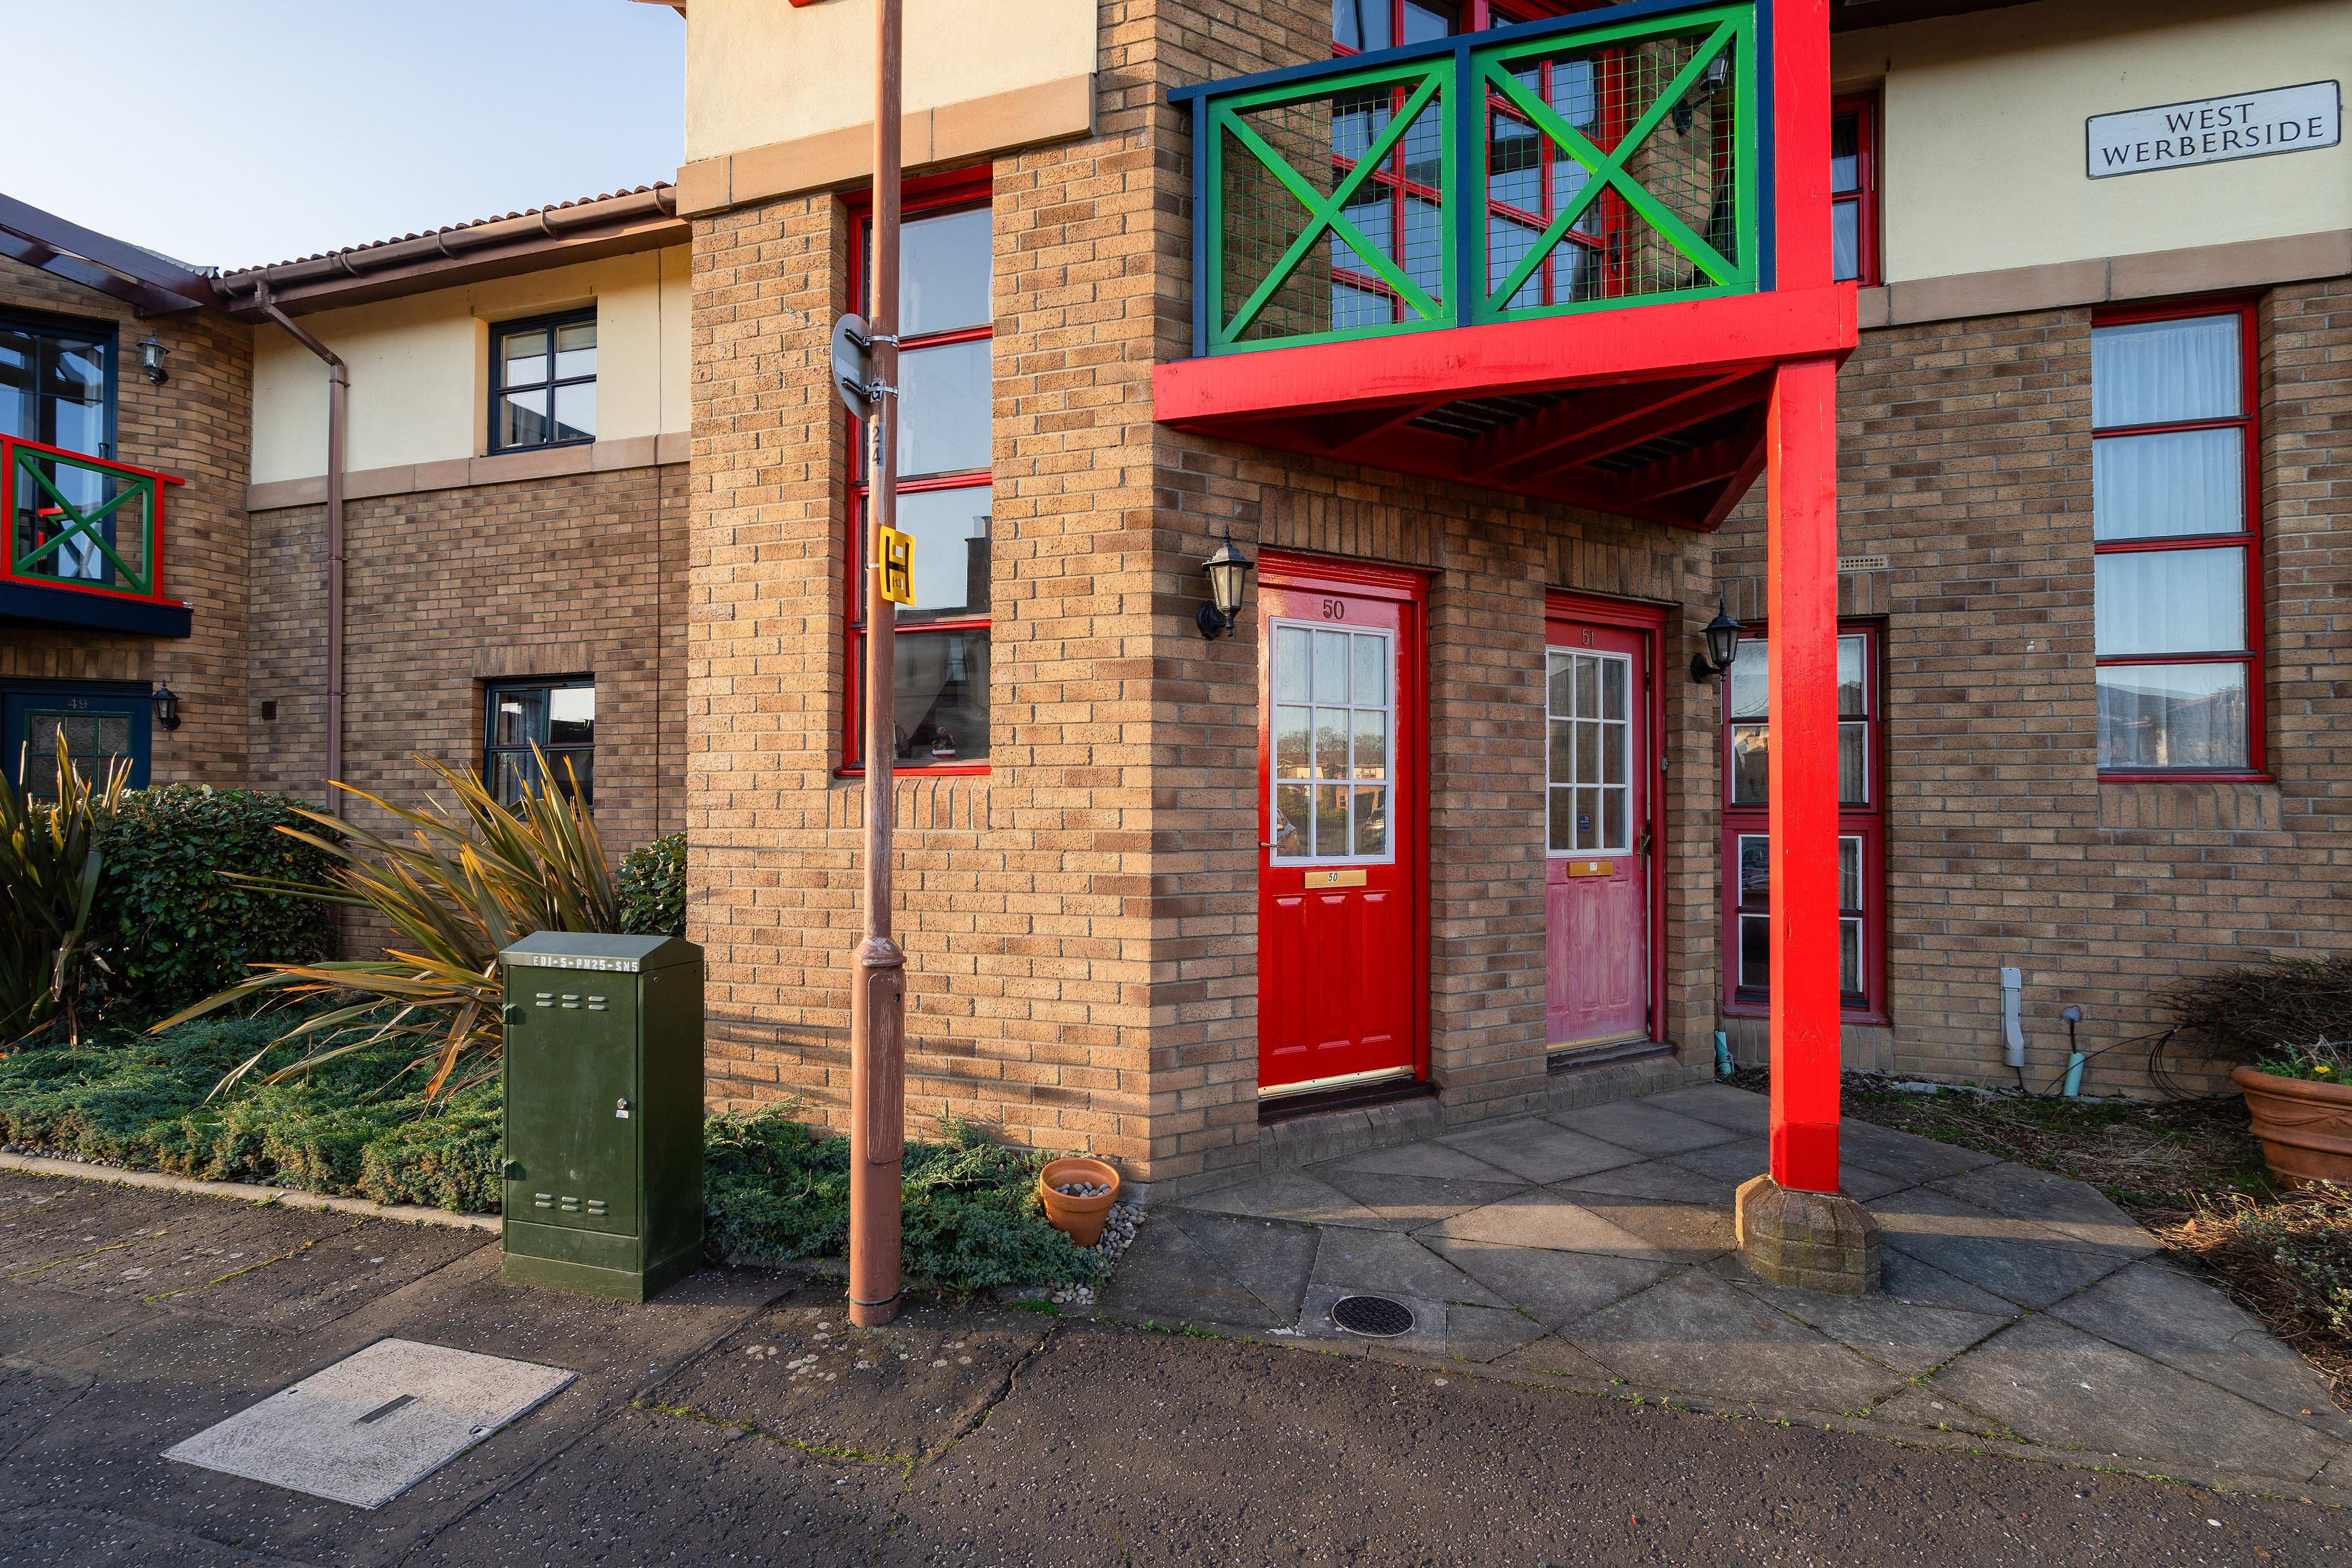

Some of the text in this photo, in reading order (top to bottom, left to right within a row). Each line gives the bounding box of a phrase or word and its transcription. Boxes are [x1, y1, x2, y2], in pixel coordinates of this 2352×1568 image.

[2165, 102, 2255, 134] WEST
[2101, 116, 2325, 167] WERBERSIDE
[1323, 599, 1345, 619] 50
[1582, 629, 1594, 646] 51
[67, 698, 88, 709] 49
[1328, 873, 1338, 881] 50
[533, 956, 638, 972] EDI-5-PN25-SN5
